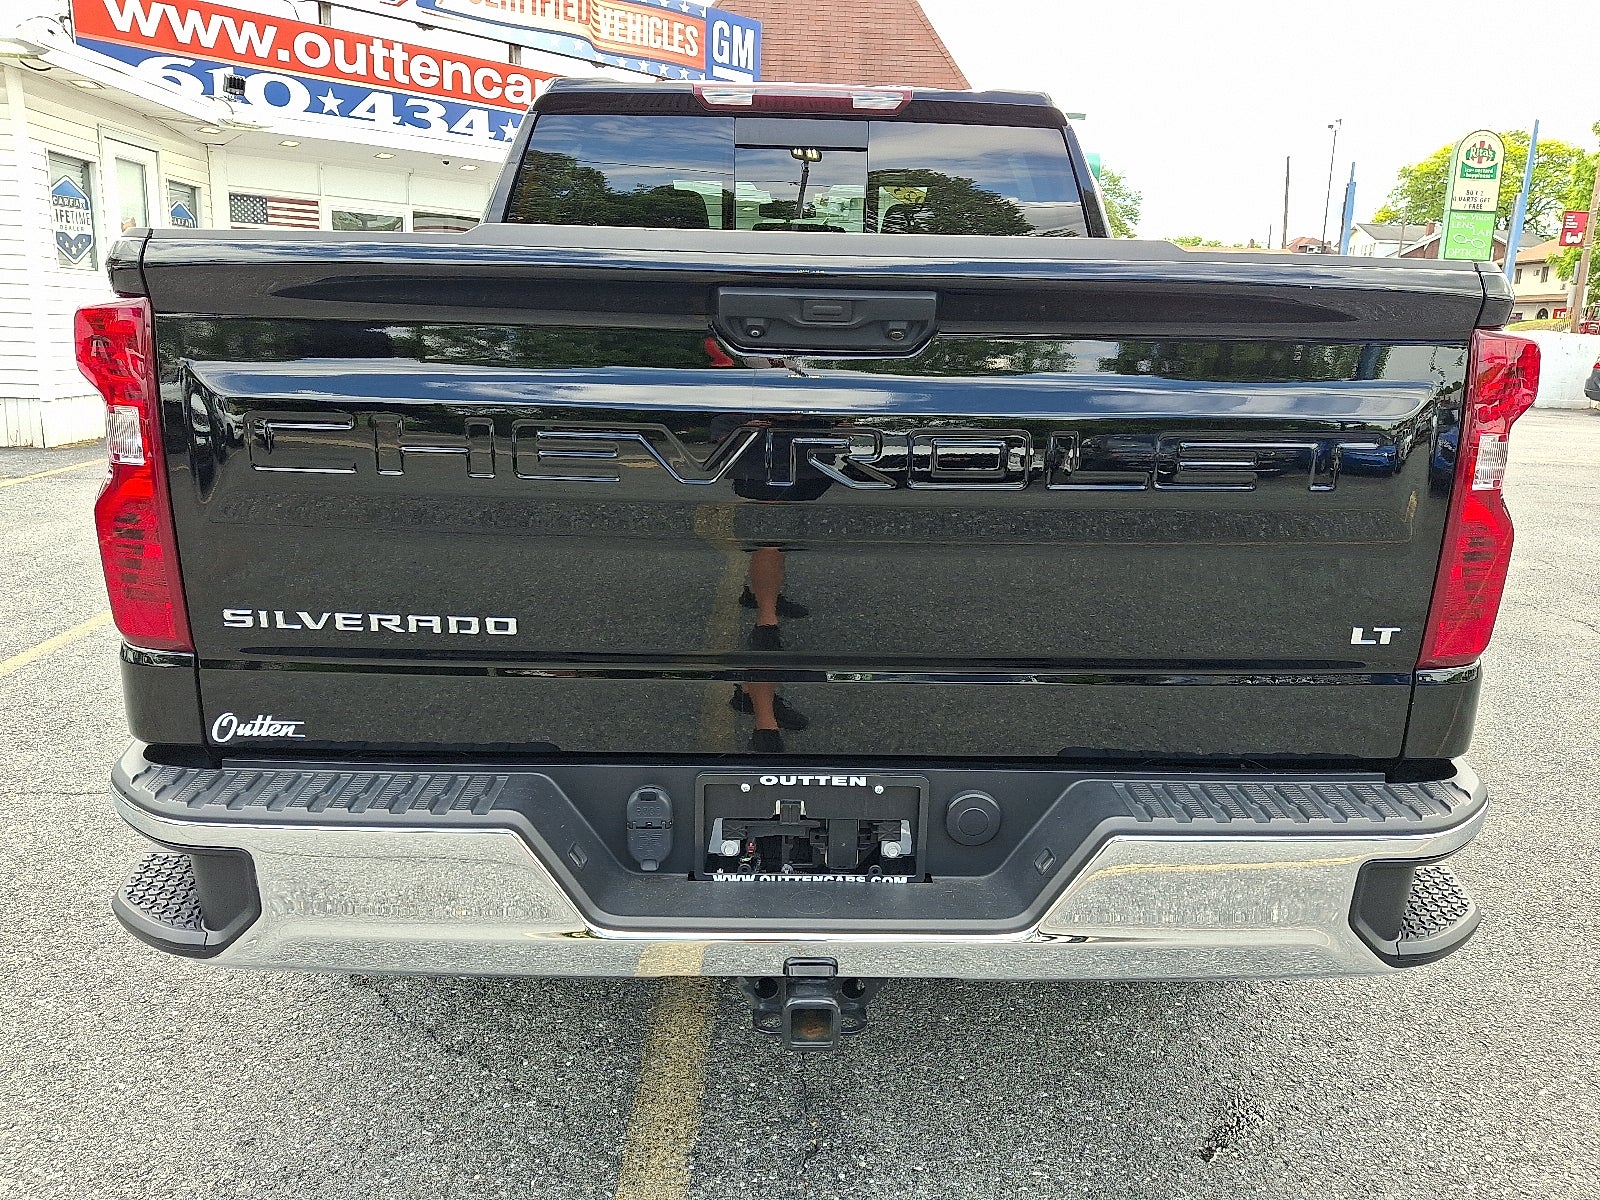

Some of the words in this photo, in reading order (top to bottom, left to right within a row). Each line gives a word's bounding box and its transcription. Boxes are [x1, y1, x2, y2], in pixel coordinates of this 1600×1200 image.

[470, 0, 591, 25] IFIED
[599, 6, 699, 57] VEHICLES
[712, 19, 755, 71] GM
[136, 55, 312, 112] 610
[346, 88, 499, 143] 434
[53, 195, 86, 209] CARFAX
[54, 209, 90, 225] IFETIME
[242, 410, 1386, 491] CHEVROLET
[222, 607, 519, 636] SILVERADO
[1350, 626, 1402, 646] LT
[211, 711, 306, 744] Outten
[759, 775, 868, 788] OUTTEN
[712, 874, 909, 884] WWWOUTTENCARSCOM
